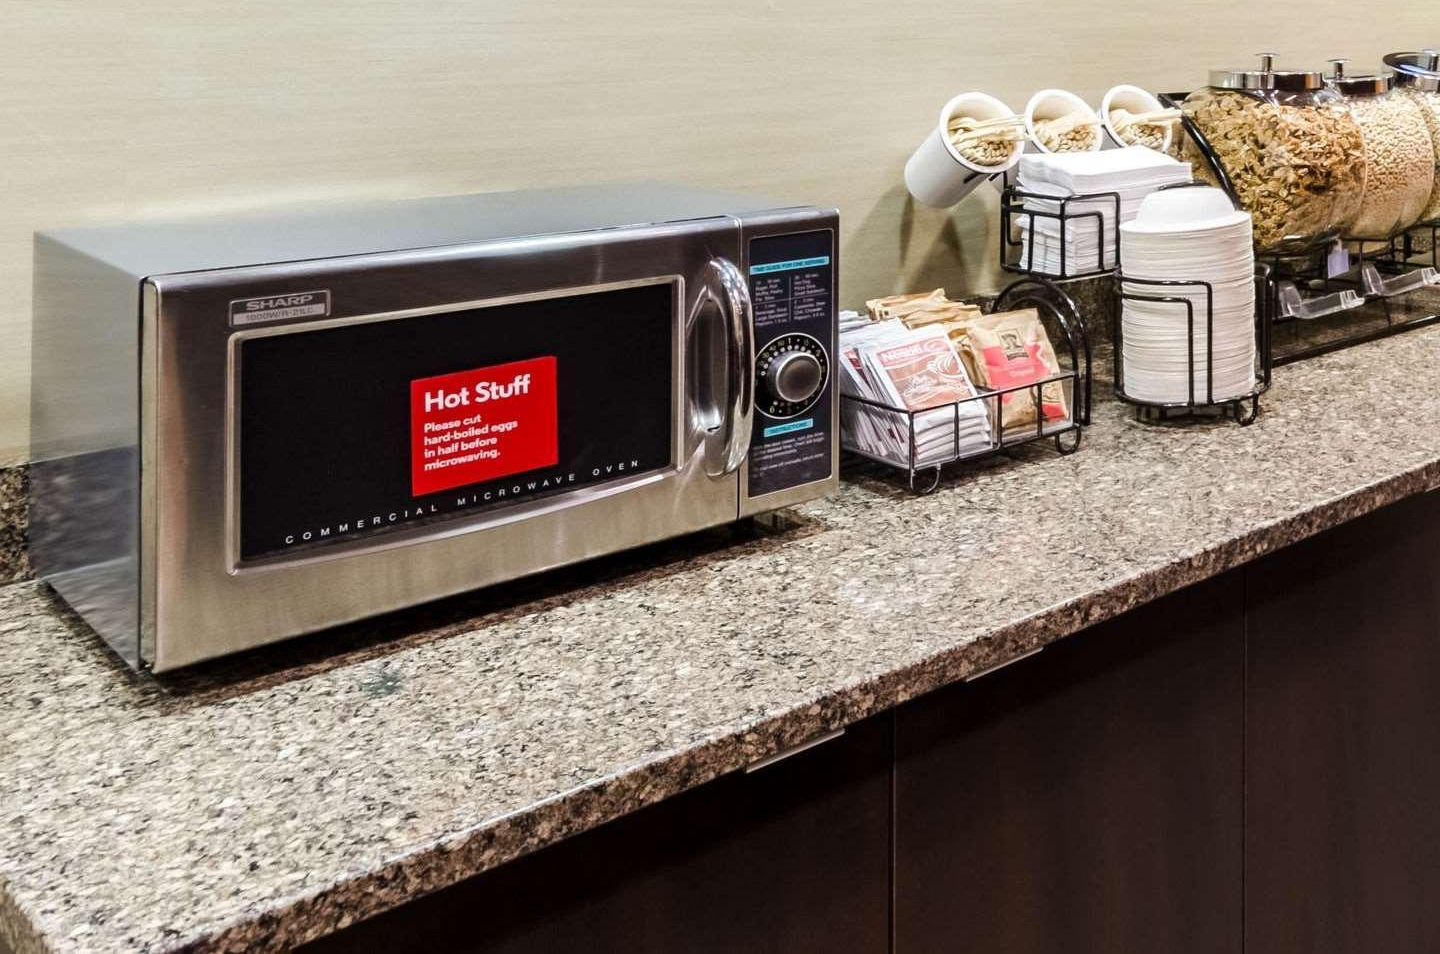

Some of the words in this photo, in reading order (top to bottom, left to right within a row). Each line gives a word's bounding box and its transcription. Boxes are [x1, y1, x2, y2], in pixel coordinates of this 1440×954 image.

[246, 295, 313, 310] SHARP
[424, 387, 470, 412] Hot
[475, 373, 531, 403] Stuff
[424, 419, 461, 433] Please
[463, 414, 481, 426] cut
[424, 424, 489, 445] hard-boiled
[490, 420, 518, 432] eggs
[424, 448, 435, 458] in
[437, 441, 459, 456] half
[460, 437, 498, 451] before
[424, 448, 501, 471] microwaving.
[285, 505, 438, 544] COMMERCIAL
[457, 473, 576, 506] MICROWAVE
[592, 459, 639, 477] OVEN
